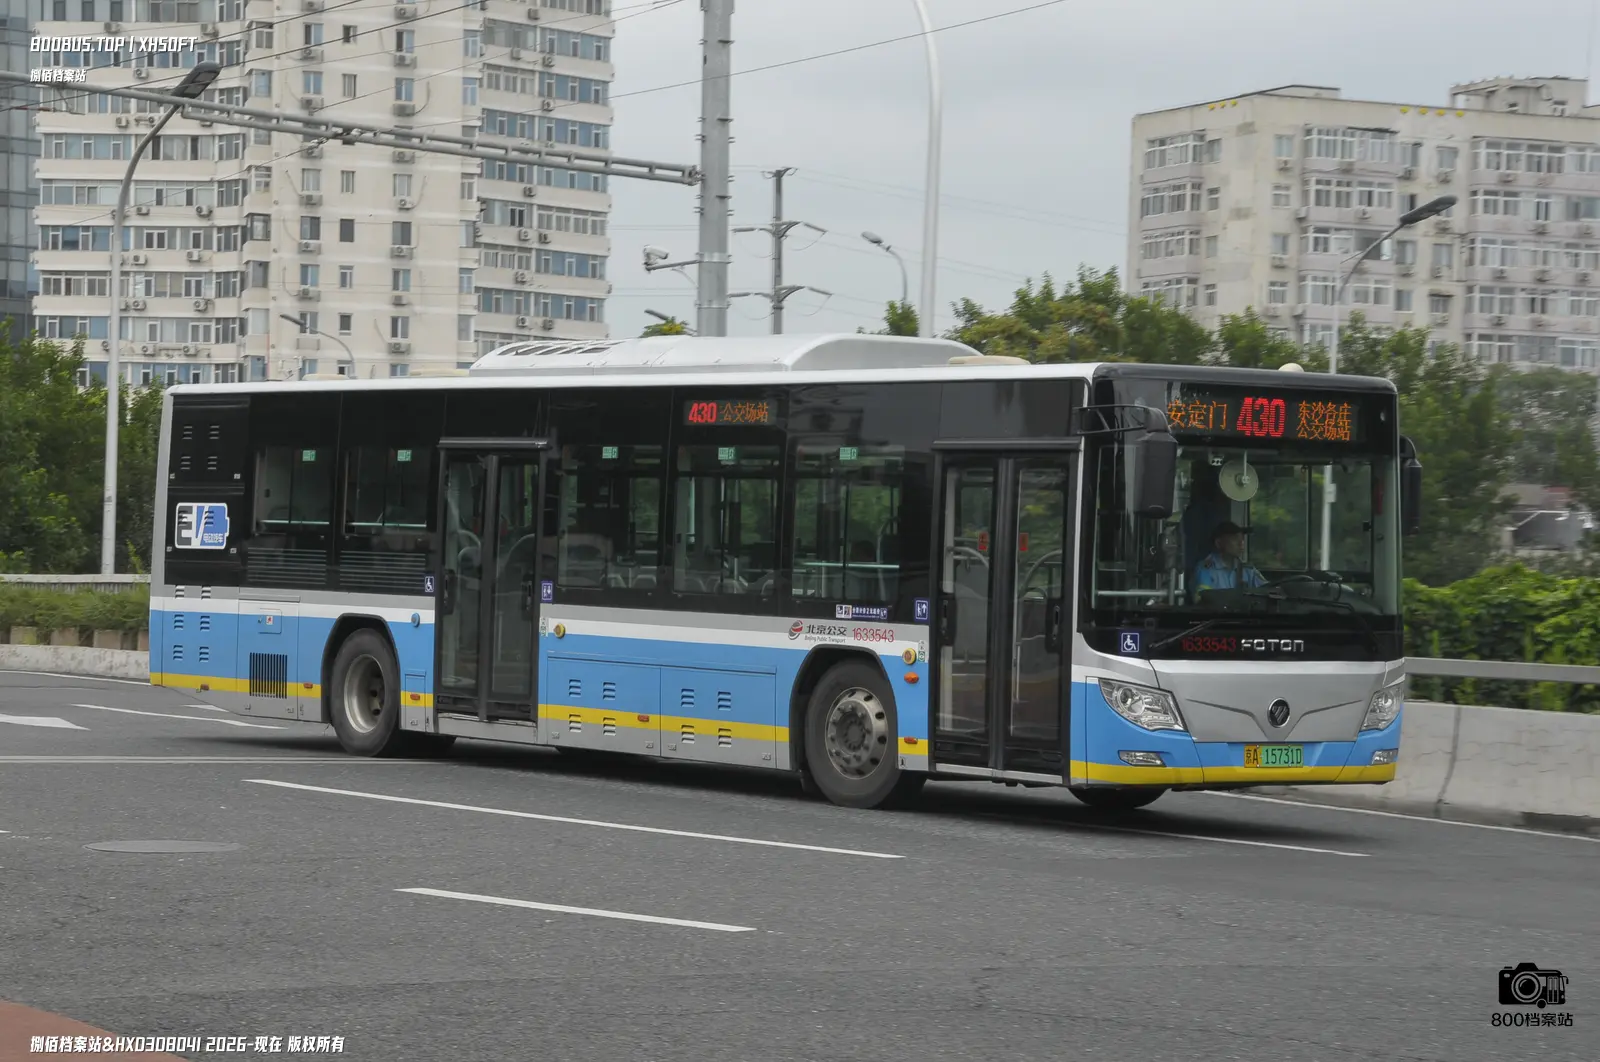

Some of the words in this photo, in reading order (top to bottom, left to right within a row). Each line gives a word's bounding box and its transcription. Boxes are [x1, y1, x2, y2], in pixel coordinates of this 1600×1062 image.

[688, 402, 717, 423] 430
[722, 402, 769, 423] 公交场站
[1167, 399, 1228, 430] 安定门
[1236, 397, 1287, 437] 430
[806, 624, 847, 637] 北京公交
[852, 627, 895, 643] 1633543
[1182, 637, 1237, 653] 1633543
